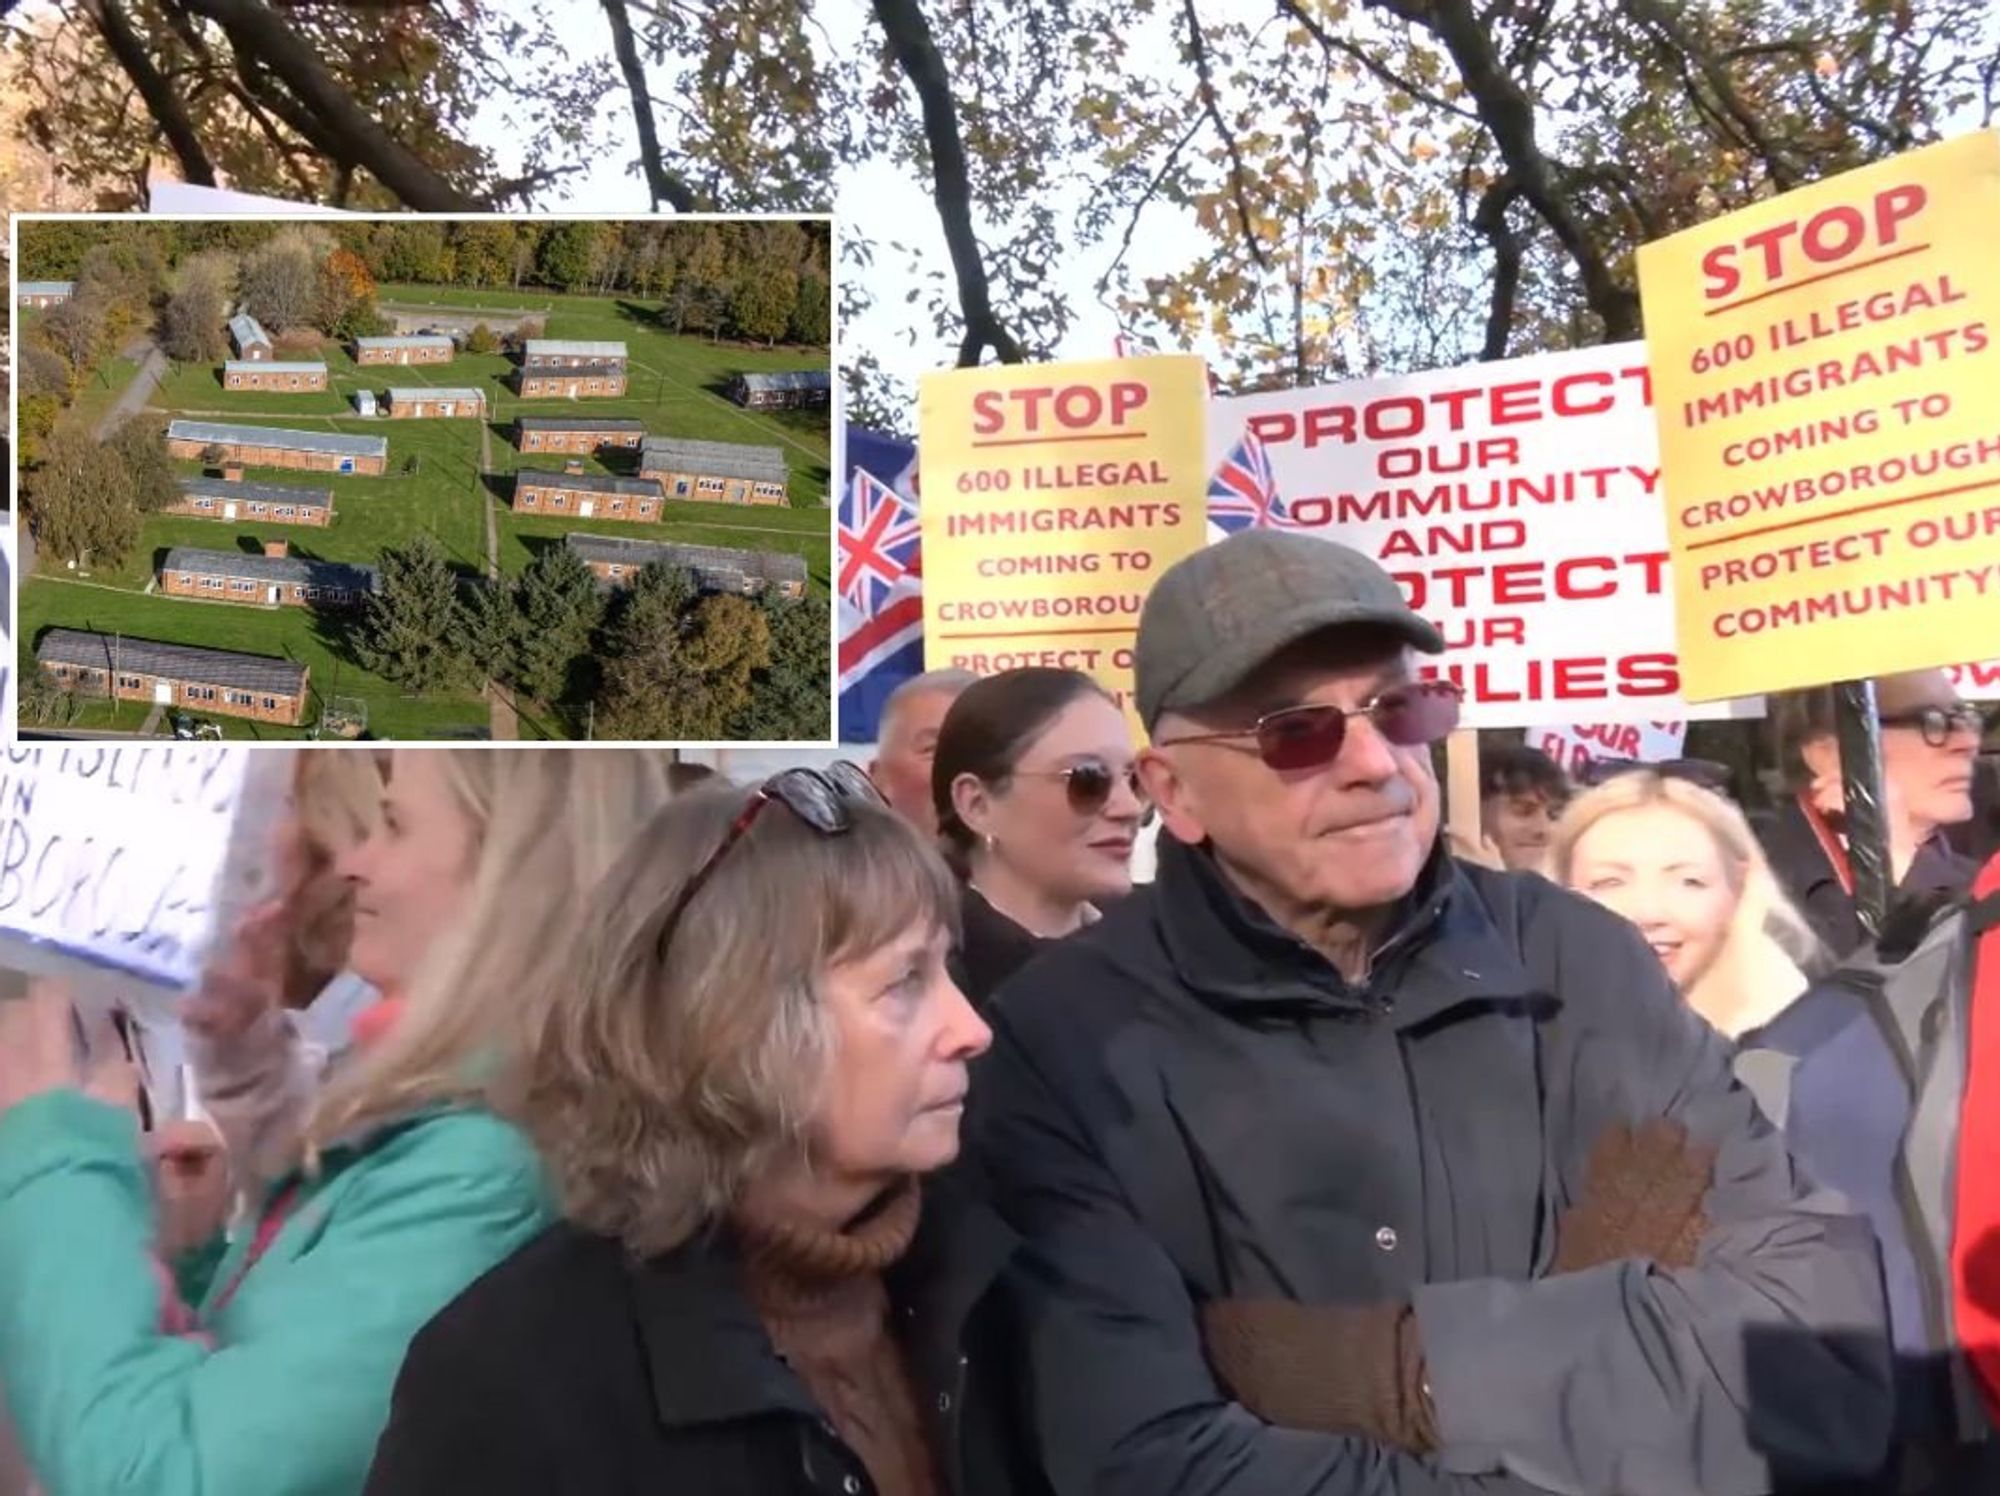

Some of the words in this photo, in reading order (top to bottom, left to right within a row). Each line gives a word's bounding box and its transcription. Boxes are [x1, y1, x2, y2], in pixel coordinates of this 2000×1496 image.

[1702, 183, 1928, 300] STOP
[1691, 334, 1754, 375] 600
[1769, 275, 1966, 352] ILLEGAL
[1684, 322, 1988, 428] IMMIGRANTS
[972, 382, 1148, 434] STOP
[1722, 409, 1879, 467] COMING
[1893, 392, 1951, 425] TO
[956, 470, 1011, 493] 600
[1023, 461, 1168, 490] ILLEGAL
[1376, 437, 1520, 479] OUR
[1681, 434, 2000, 529] CROWBOROUGH
[947, 503, 1181, 537] IMMIGRANTS
[1290, 466, 1663, 527] OMMUNITY
[977, 553, 1100, 577] COMING
[1110, 552, 1152, 571] TO
[1378, 519, 1527, 560] AND
[1702, 530, 1891, 591] PROTECT
[1907, 507, 2000, 548] OUR
[938, 595, 1140, 622] CROWBOROU
[1713, 564, 2000, 638] COMMUNITY
[1433, 616, 1526, 651] UR
